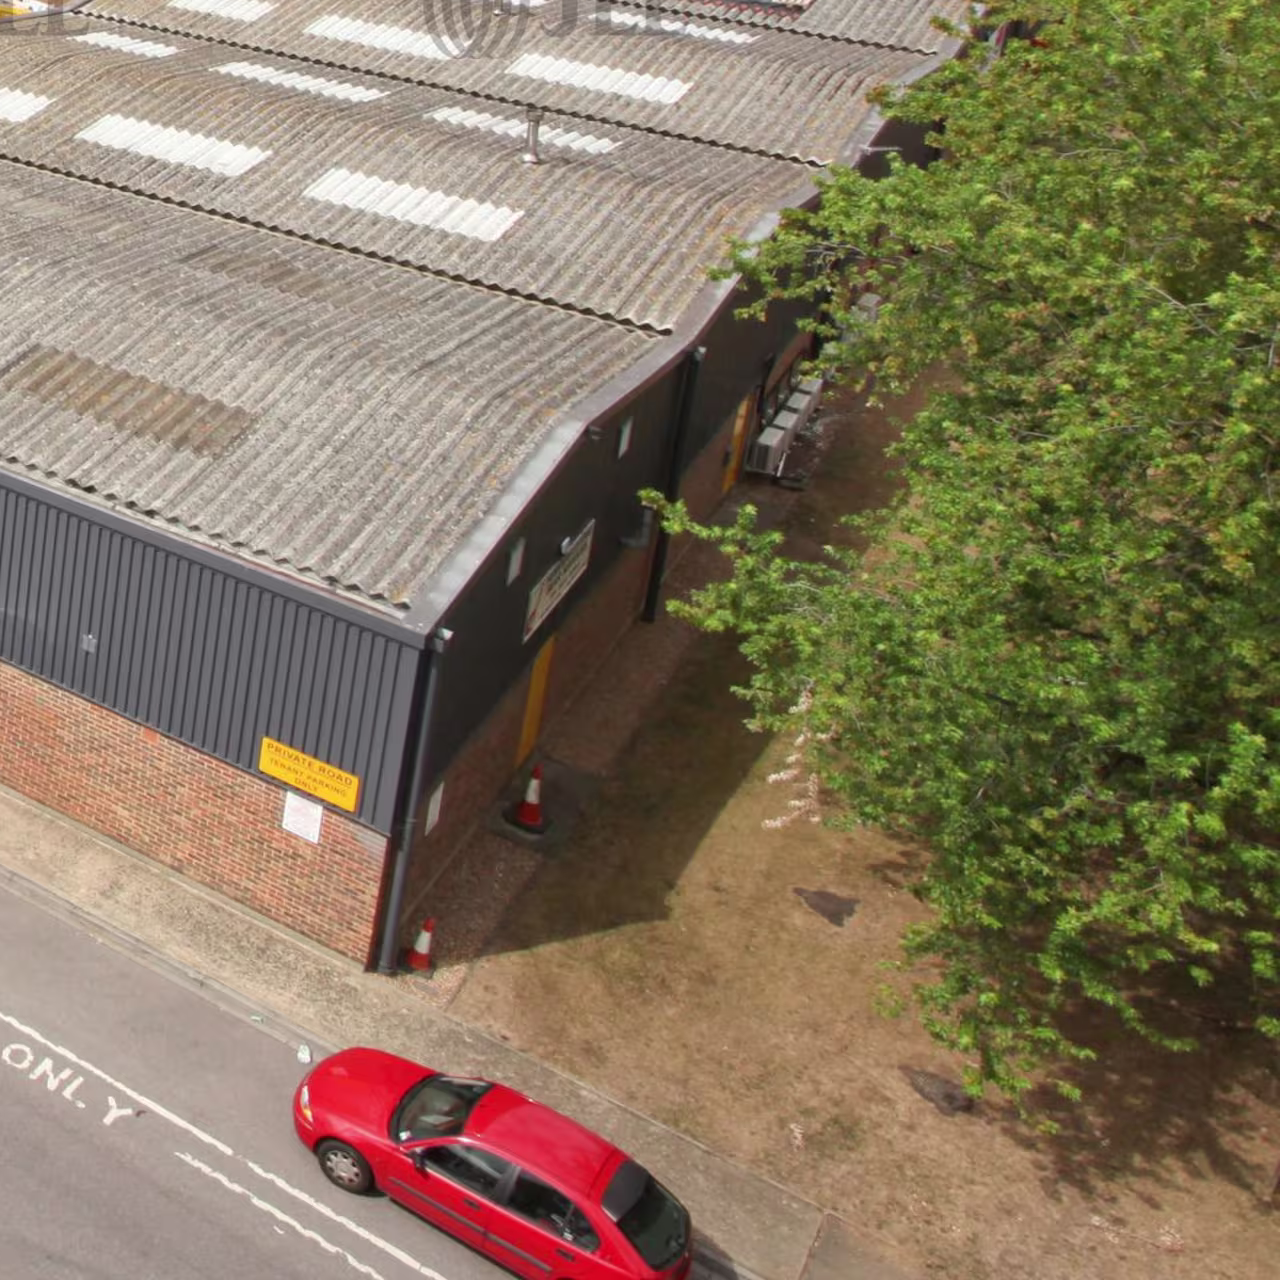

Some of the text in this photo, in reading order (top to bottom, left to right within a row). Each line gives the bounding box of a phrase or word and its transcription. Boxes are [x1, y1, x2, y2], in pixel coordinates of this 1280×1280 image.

[267, 742, 353, 787] PRIVATE ROAD
[270, 758, 347, 798] TENANT PARKING
[294, 777, 318, 792] ONLY
[1, 1042, 133, 1127] ONLY
